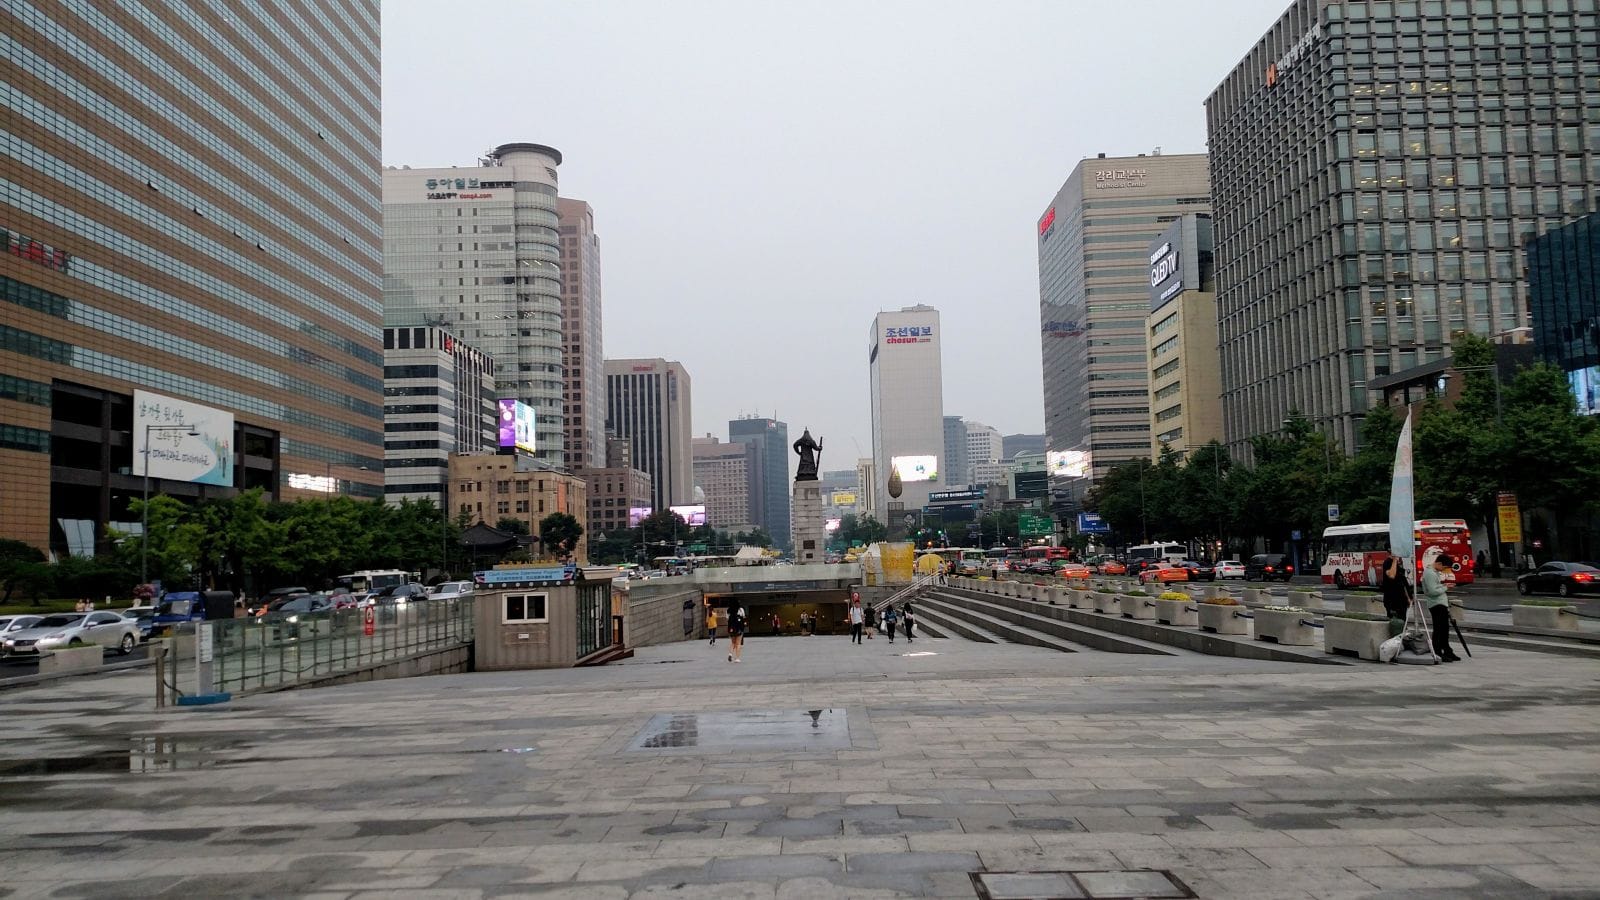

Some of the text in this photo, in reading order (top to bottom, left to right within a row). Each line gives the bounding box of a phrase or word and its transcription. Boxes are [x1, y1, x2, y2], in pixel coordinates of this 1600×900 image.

[1095, 170, 1146, 181] 감리교본부
[426, 178, 479, 190] 동아일보
[1151, 251, 1176, 287] QLED TV
[886, 327, 932, 337] 조선일보
[1329, 557, 1362, 567] Seoul City Tour
